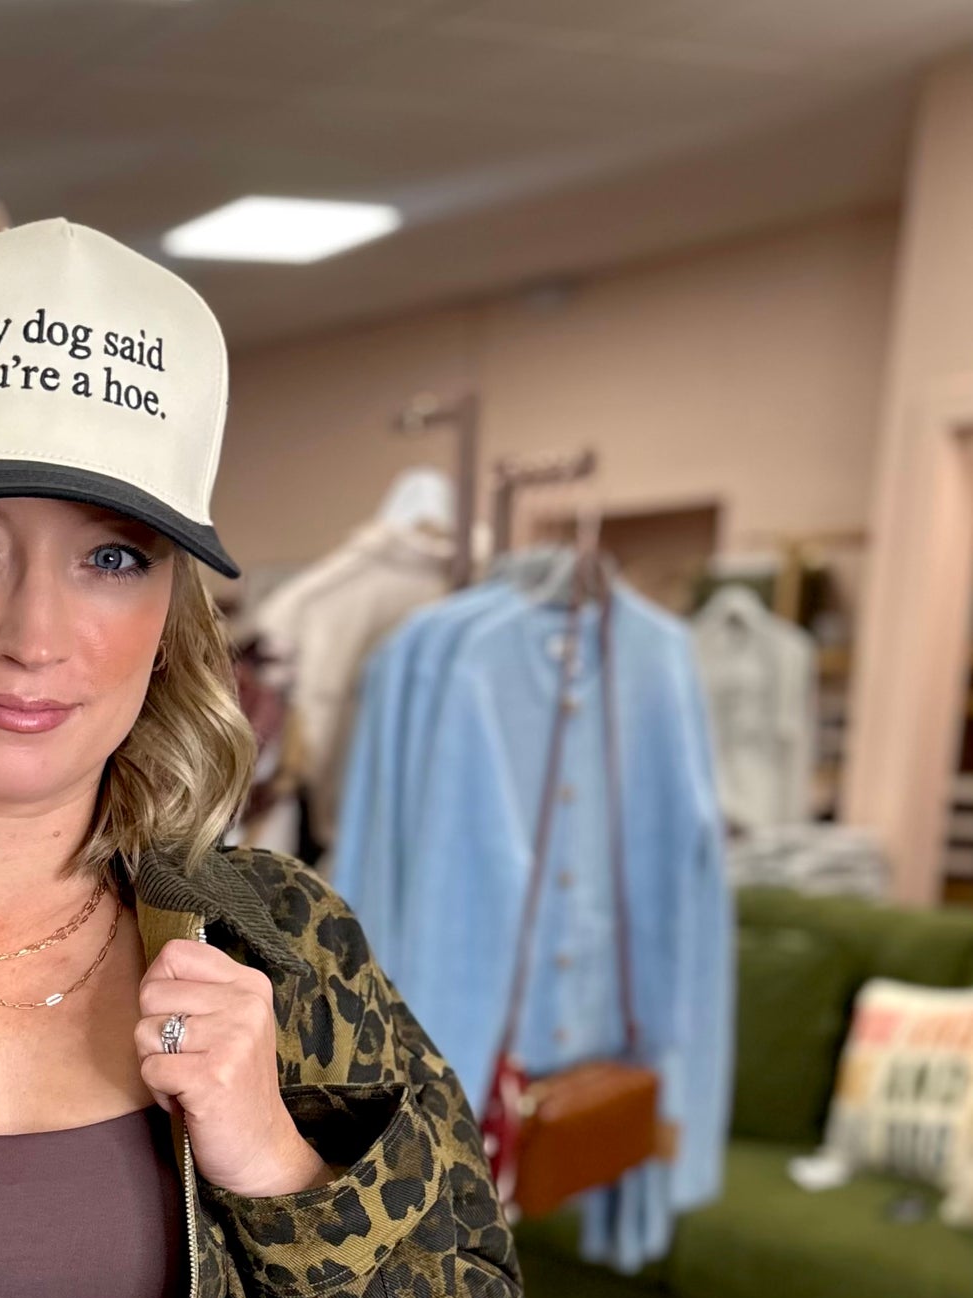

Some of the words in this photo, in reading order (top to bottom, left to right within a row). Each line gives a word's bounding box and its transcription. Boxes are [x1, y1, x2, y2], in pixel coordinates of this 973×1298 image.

[23, 308, 93, 359] dog
[103, 330, 165, 371] said
[72, 371, 92, 397] a
[102, 367, 166, 419] hoe.
